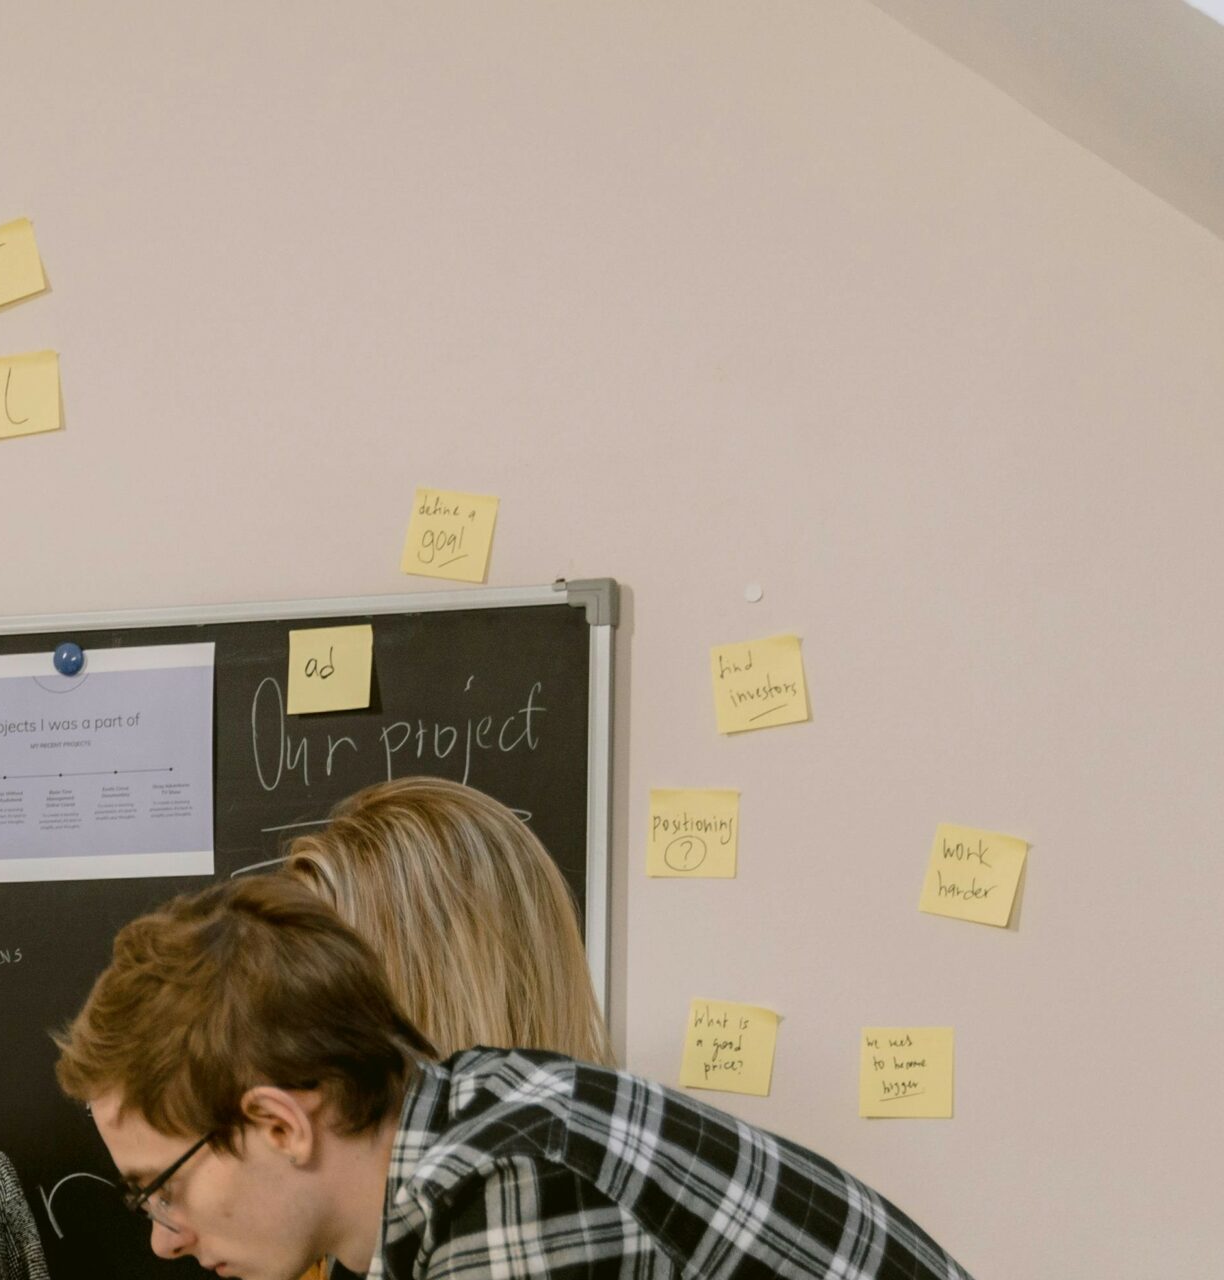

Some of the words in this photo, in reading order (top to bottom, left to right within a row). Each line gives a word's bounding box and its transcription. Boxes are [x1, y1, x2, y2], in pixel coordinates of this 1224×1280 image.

[417, 525, 466, 565] goal
[304, 646, 336, 680] ad
[728, 672, 797, 708] investors
[40, 718, 45, 732] I
[48, 716, 78, 731] was
[81, 717, 91, 730] a
[94, 714, 123, 733] part
[126, 712, 141, 728] of
[251, 676, 359, 792] Our
[379, 676, 548, 787] project
[652, 810, 734, 845] positioning
[942, 838, 993, 868] work
[937, 870, 999, 901] harder
[711, 1034, 743, 1063] good
[703, 1060, 744, 1081] price?
